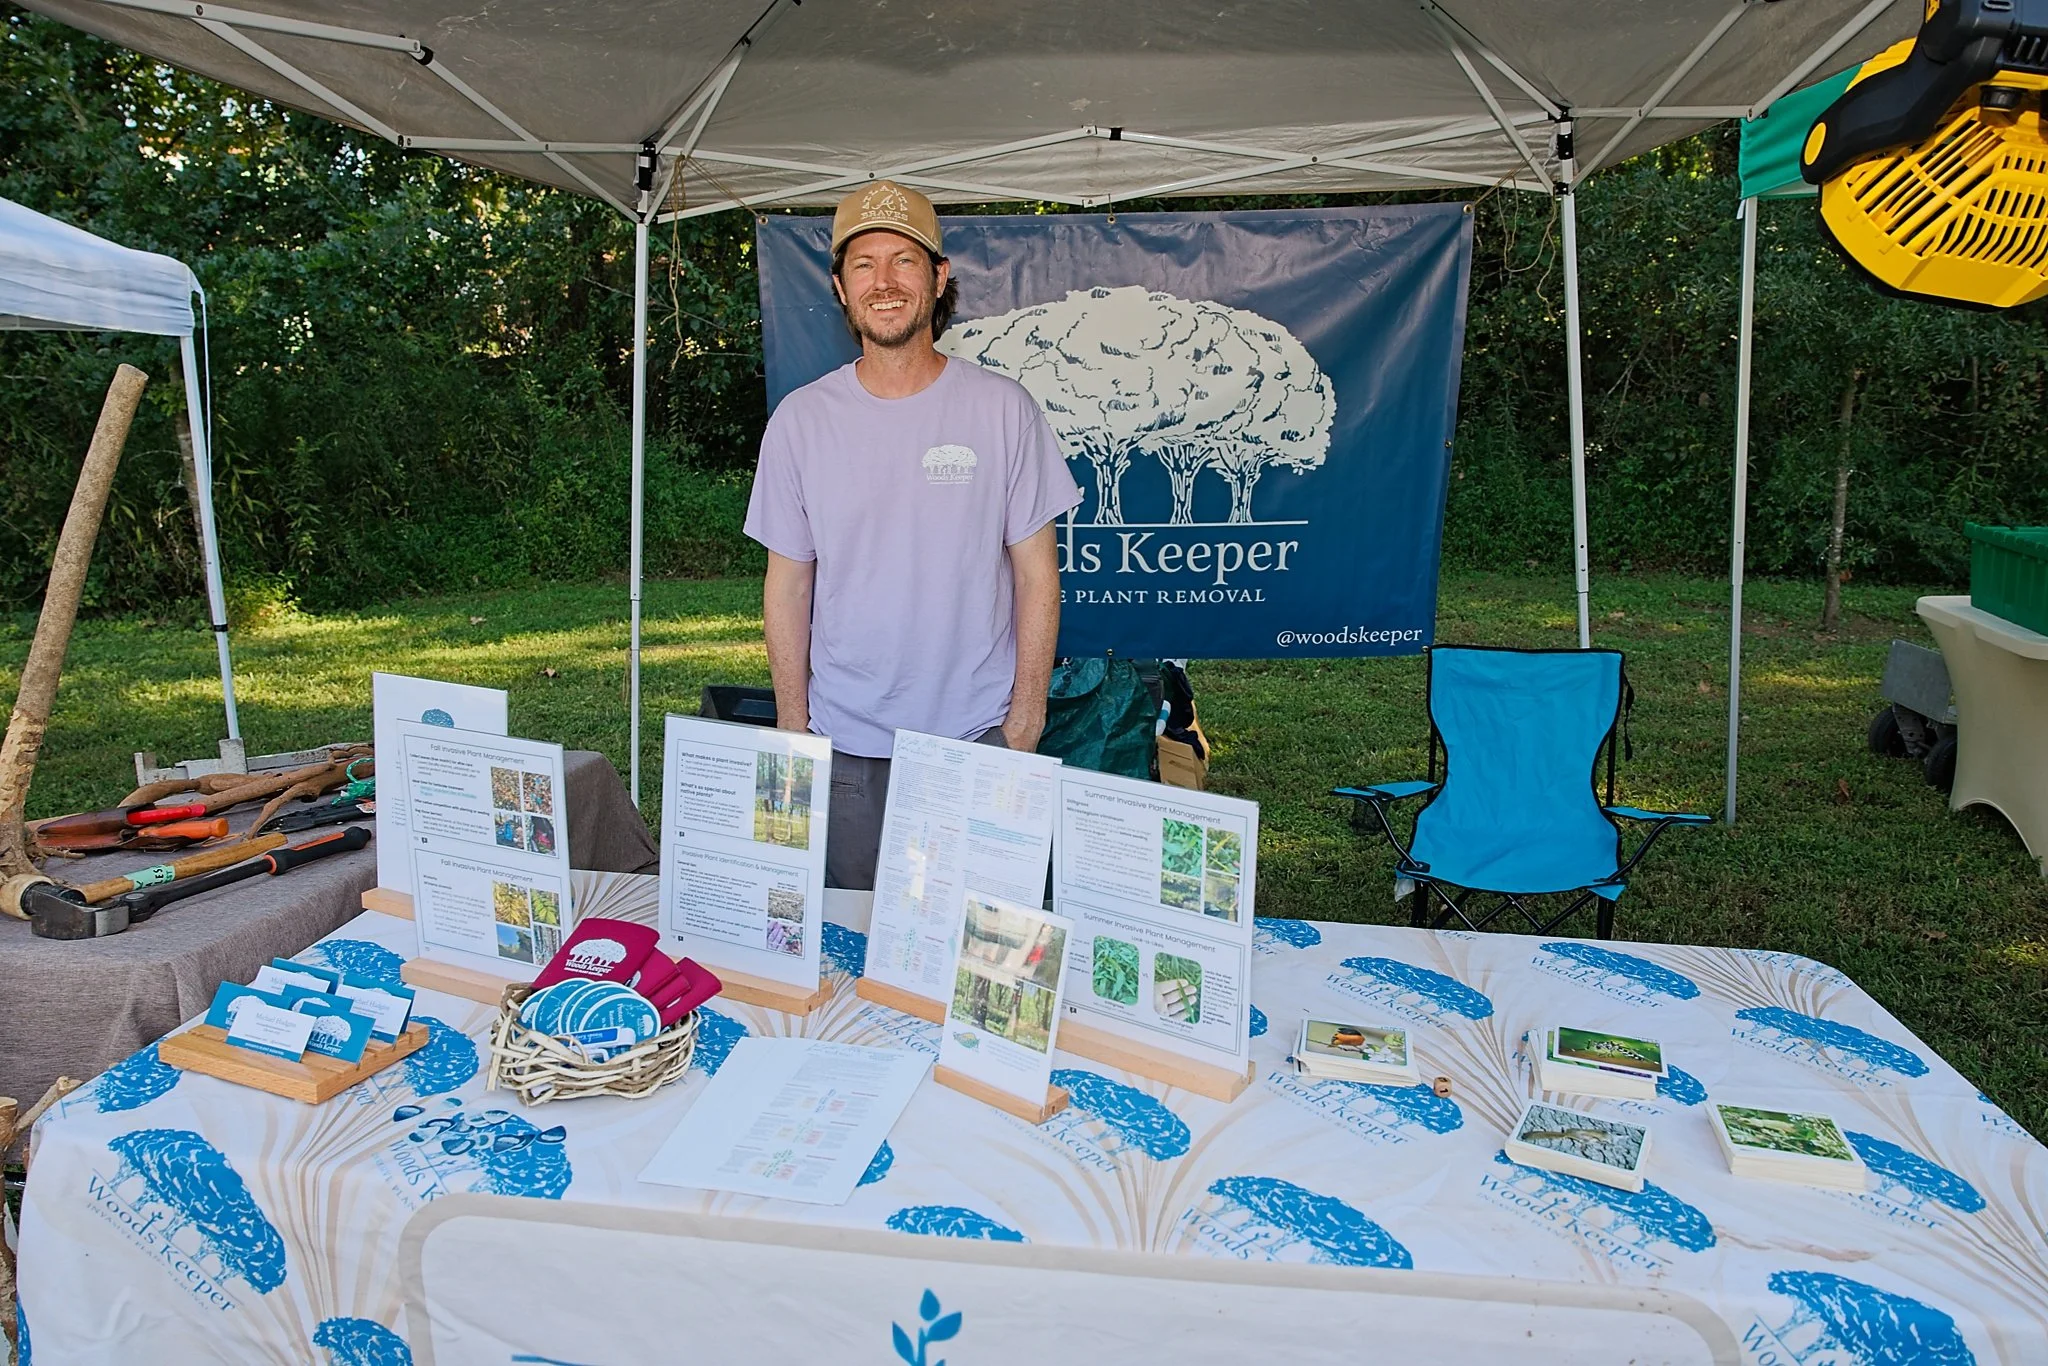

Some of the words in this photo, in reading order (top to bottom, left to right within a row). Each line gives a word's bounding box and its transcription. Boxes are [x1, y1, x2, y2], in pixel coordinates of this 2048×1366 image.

[860, 210, 908, 221] BRAVES
[862, 185, 908, 211] ATLANTA
[1115, 531, 1299, 586] Keeper
[1075, 590, 1149, 604] PLANT
[1157, 588, 1266, 604] REMOVAL
[1276, 626, 1423, 648] @woodskeeper
[430, 743, 441, 751] Fall
[442, 746, 466, 756] Invasive
[467, 749, 482, 758] Plant
[483, 752, 525, 765] Management
[1084, 790, 1116, 804] Summer
[1116, 795, 1147, 809] Invasive
[1148, 802, 1167, 814] Plant
[1169, 807, 1221, 826] Management
[440, 858, 451, 866] Fall
[452, 861, 476, 872] Invasive
[477, 866, 492, 875] Plant
[492, 869, 533, 882] Management
[681, 850, 703, 859] Invasive
[704, 853, 718, 862] Plant
[719, 856, 753, 869] Identification
[761, 864, 799, 878] Management
[1083, 912, 1113, 925] Summer
[1114, 920, 1144, 934] Invasive
[1145, 928, 1164, 940] Plant
[1165, 934, 1217, 953] Management
[565, 959, 588, 971] Woods
[587, 963, 612, 975] Keeper
[1532, 956, 1592, 983] Woods
[1593, 981, 1664, 1008] Keeper
[1326, 974, 1386, 1001] Woods
[1382, 999, 1448, 1028] Keeper
[1730, 1027, 1802, 1057] Woods
[1807, 1055, 1893, 1088] Keeper
[1268, 1071, 1338, 1108] Woods
[1331, 1105, 1408, 1144] Keeper
[1618, 1100, 1665, 1116] per
[386, 1139, 448, 1186] Woods
[1052, 1127, 1117, 1173] Keeper
[1480, 1174, 1564, 1221] Woods
[1563, 1218, 1662, 1270] Keeper
[1848, 1191, 1943, 1229] eeper
[88, 1175, 162, 1244] Woods
[159, 1244, 236, 1311] Keeper
[1183, 1208, 1260, 1260] Woods
